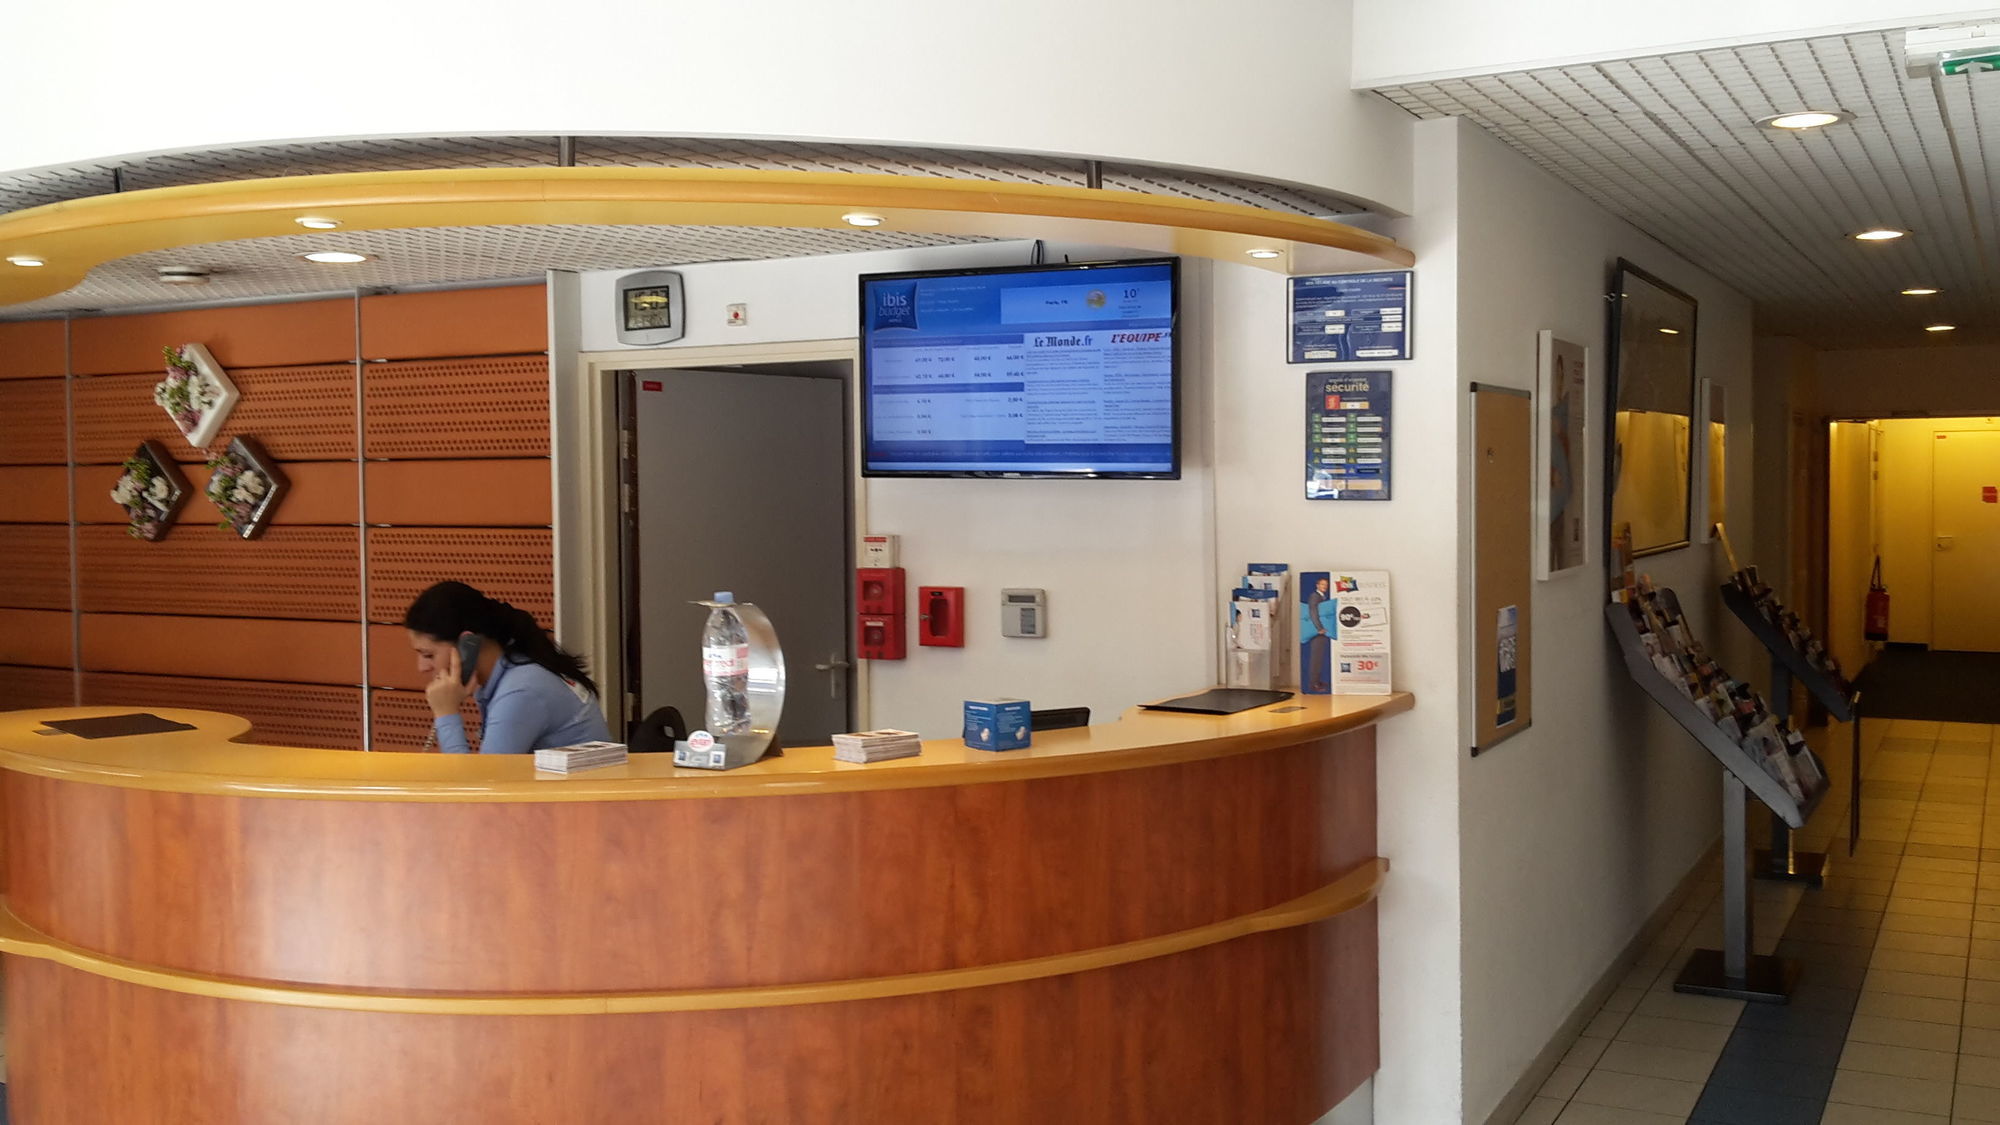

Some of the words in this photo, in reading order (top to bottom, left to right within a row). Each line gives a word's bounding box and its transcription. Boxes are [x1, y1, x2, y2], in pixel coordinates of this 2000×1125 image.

[883, 290, 907, 306] ibis
[878, 305, 911, 317] budget
[1034, 336, 1045, 348] Le
[1047, 335, 1093, 347] Monde.fr
